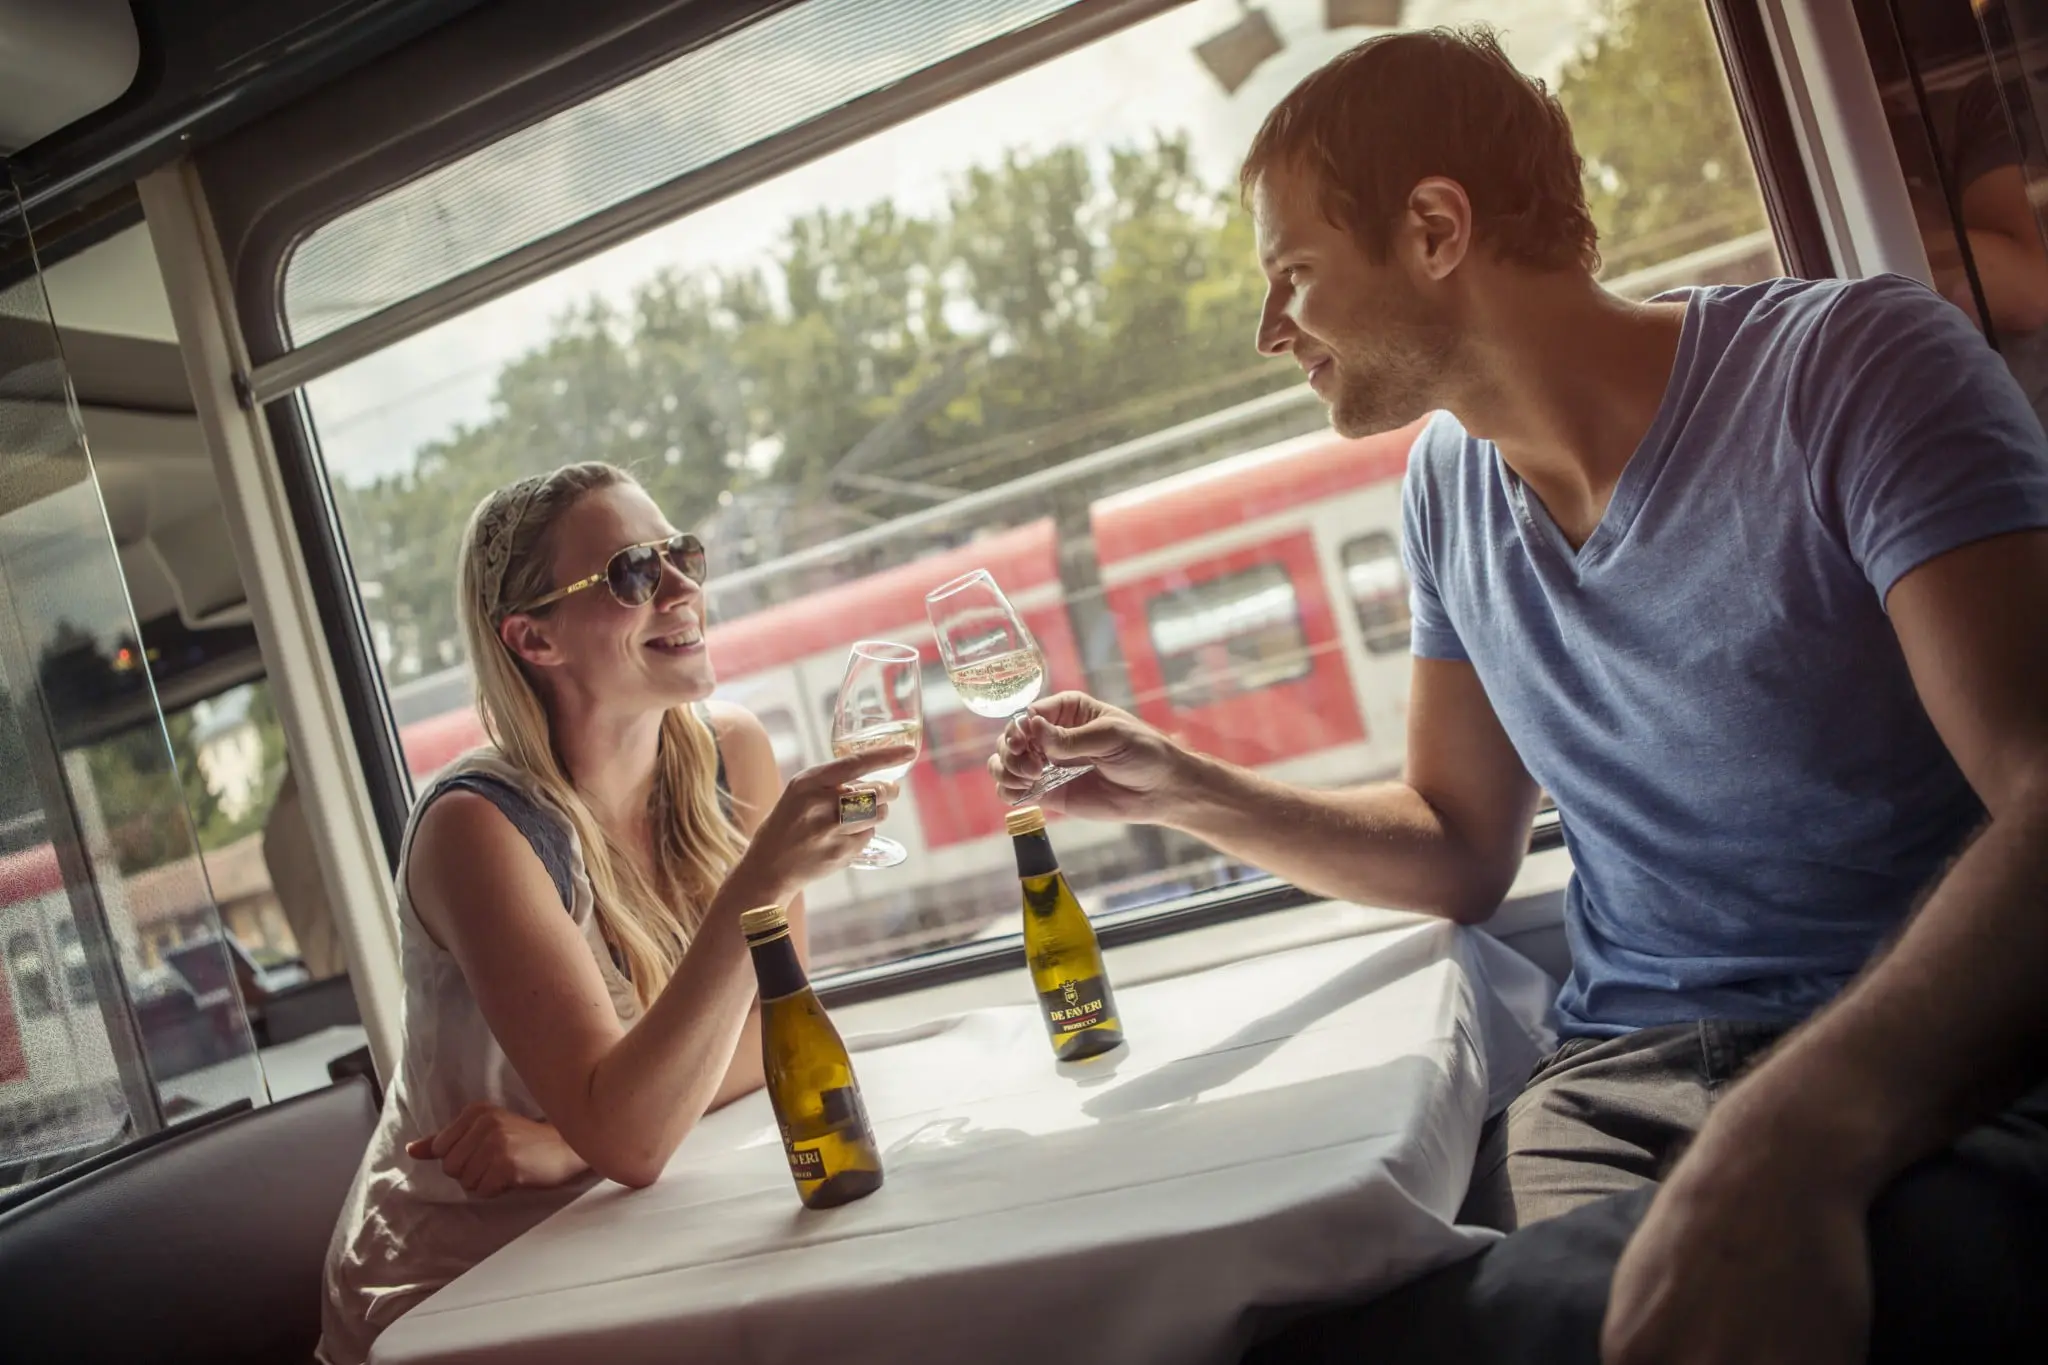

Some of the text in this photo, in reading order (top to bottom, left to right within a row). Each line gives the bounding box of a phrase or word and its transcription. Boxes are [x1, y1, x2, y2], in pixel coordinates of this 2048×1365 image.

[1050, 999, 1103, 1021] DE FAVERI
[1063, 1018, 1097, 1031] PROSECCO
